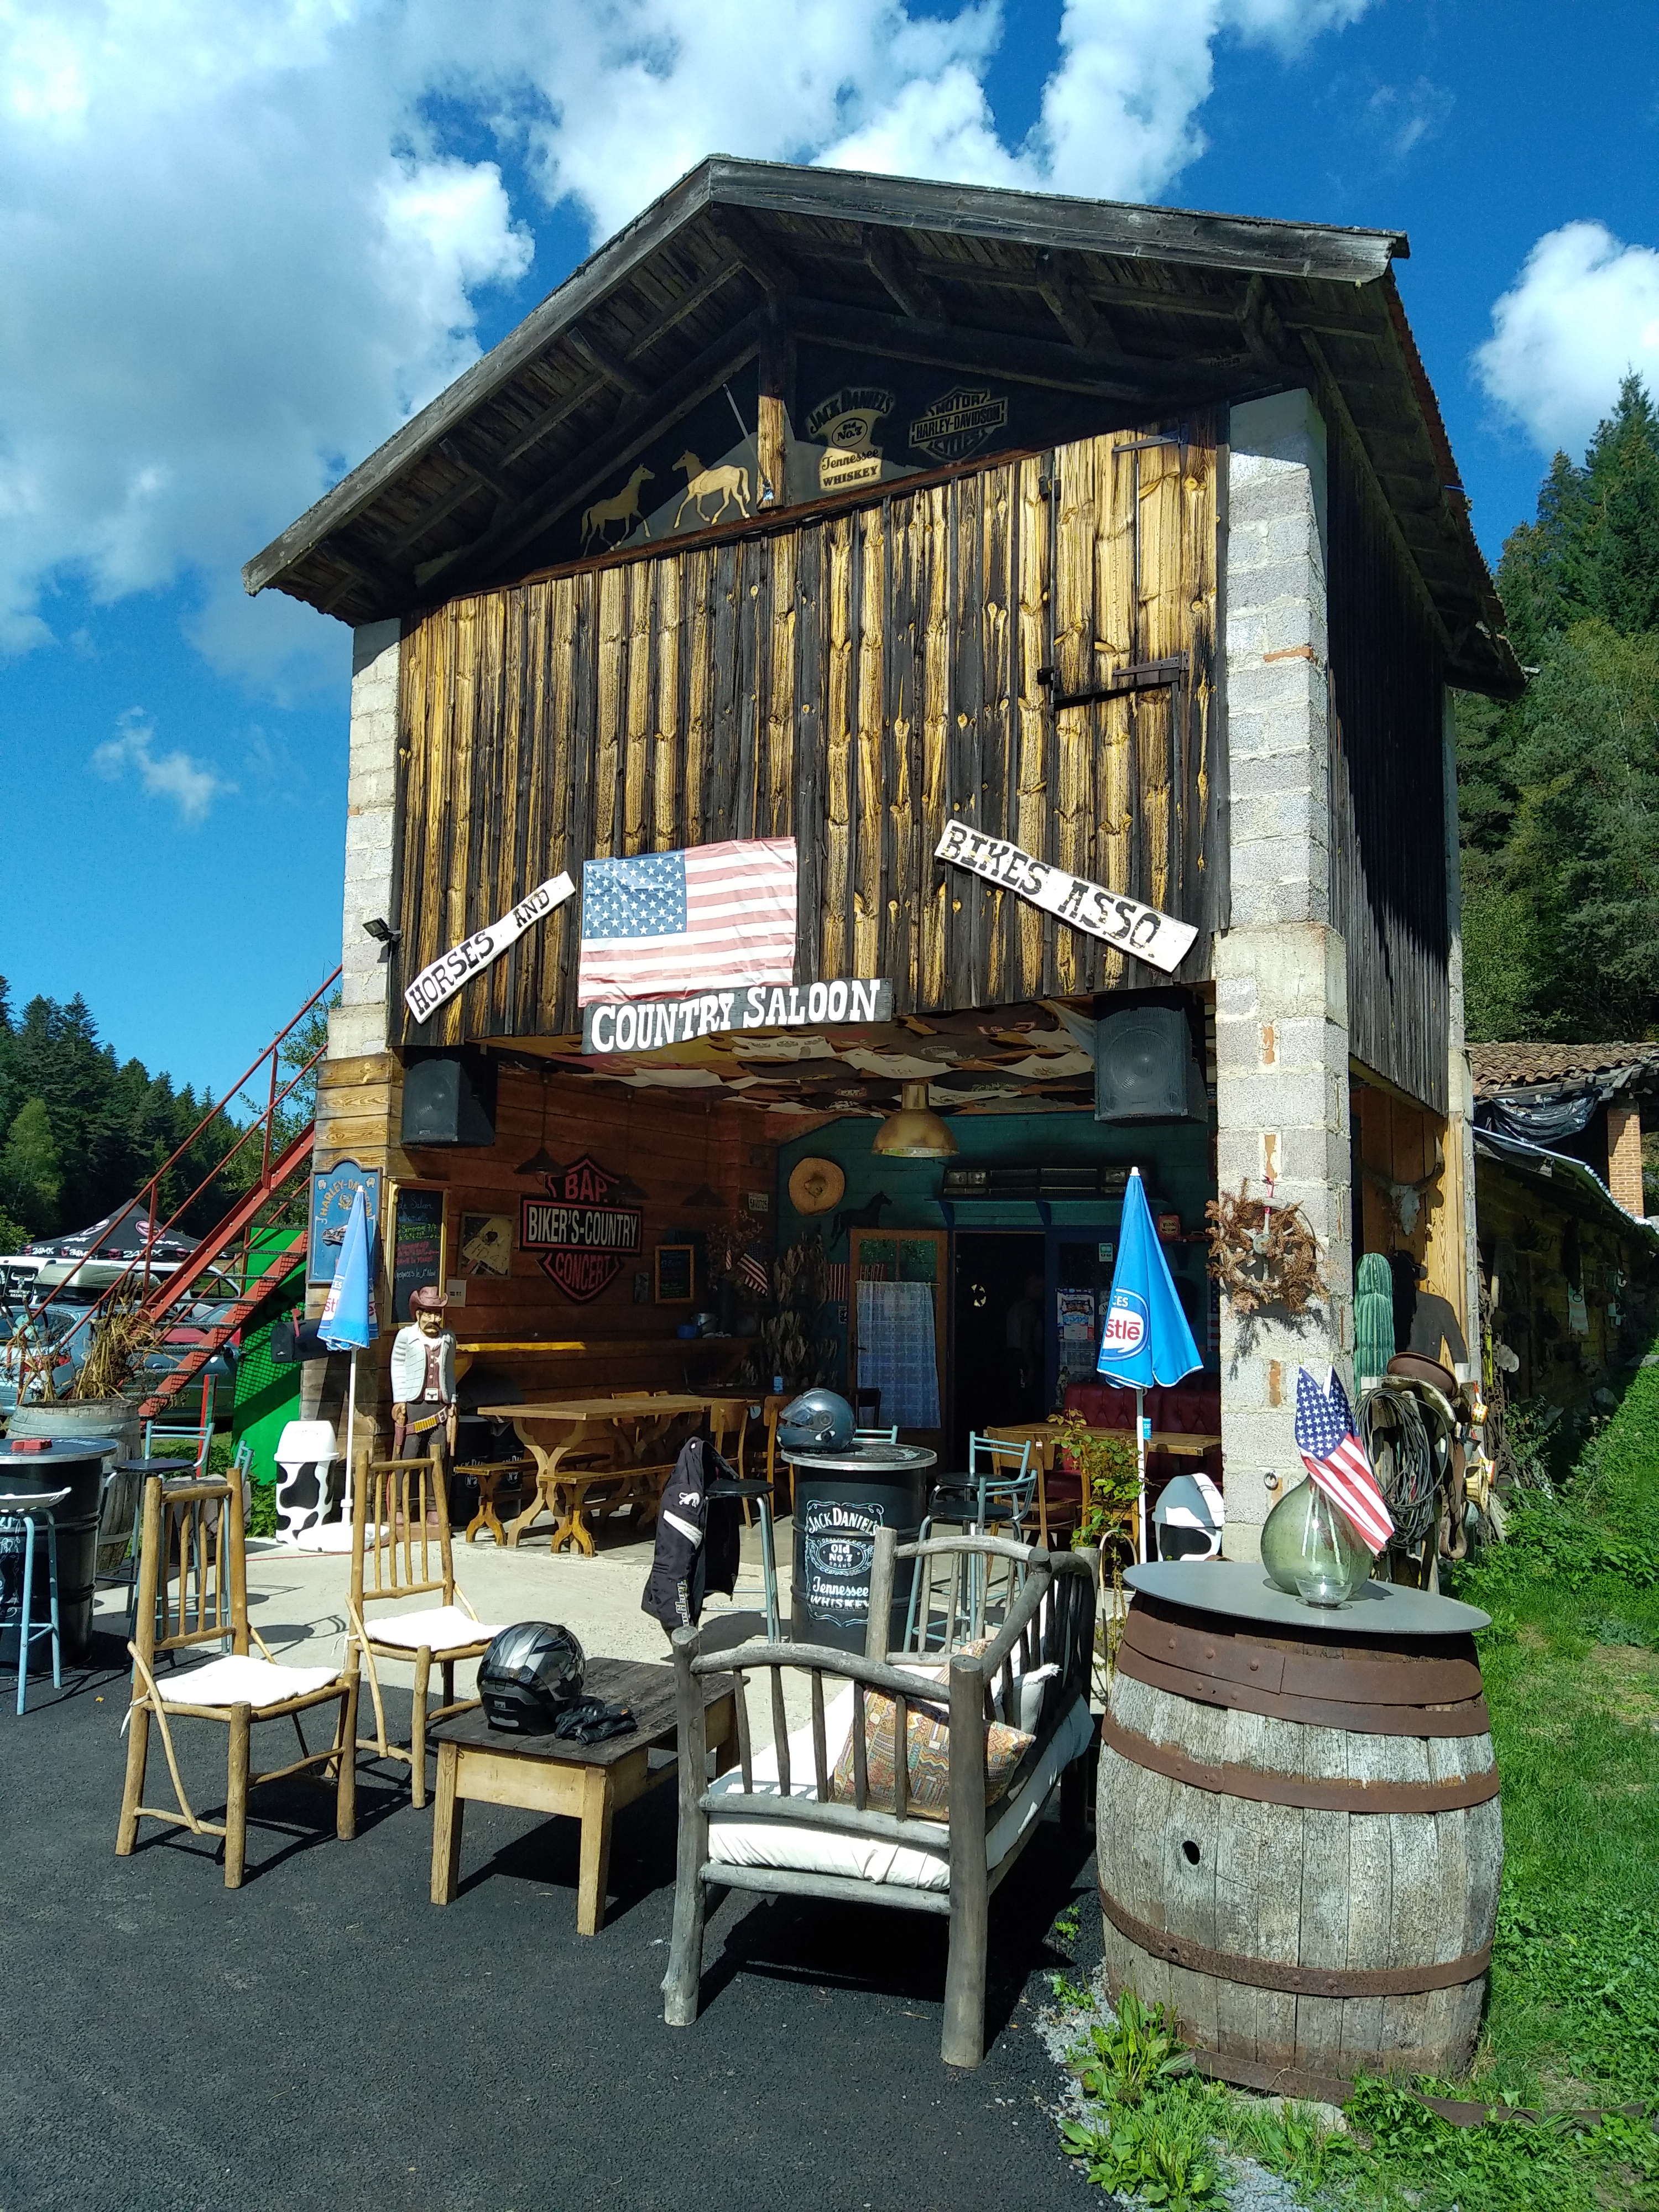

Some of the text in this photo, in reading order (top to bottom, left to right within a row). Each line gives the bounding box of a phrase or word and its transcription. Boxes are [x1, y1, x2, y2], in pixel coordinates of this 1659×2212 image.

[936, 395, 980, 414] MOTOR
[916, 405, 1000, 439] HARLEY-DAVIDSON
[822, 448, 879, 470] Tennessee
[823, 465, 878, 486] WHISKEY
[940, 826, 1051, 895] BIKES
[409, 888, 550, 1016] HORSES AND
[591, 979, 881, 1052] COUNTRY SALOON
[528, 1206, 638, 1248] BIKER'S-COUNTRY
[555, 1252, 612, 1291] CONCERT
[808, 1507, 880, 1536] JACK DANIEL'S
[829, 1553, 853, 1562] No.7
[831, 1544, 850, 1553] Old
[812, 1576, 869, 1597] Tennessee
[810, 1595, 870, 1610] WHISKEY
